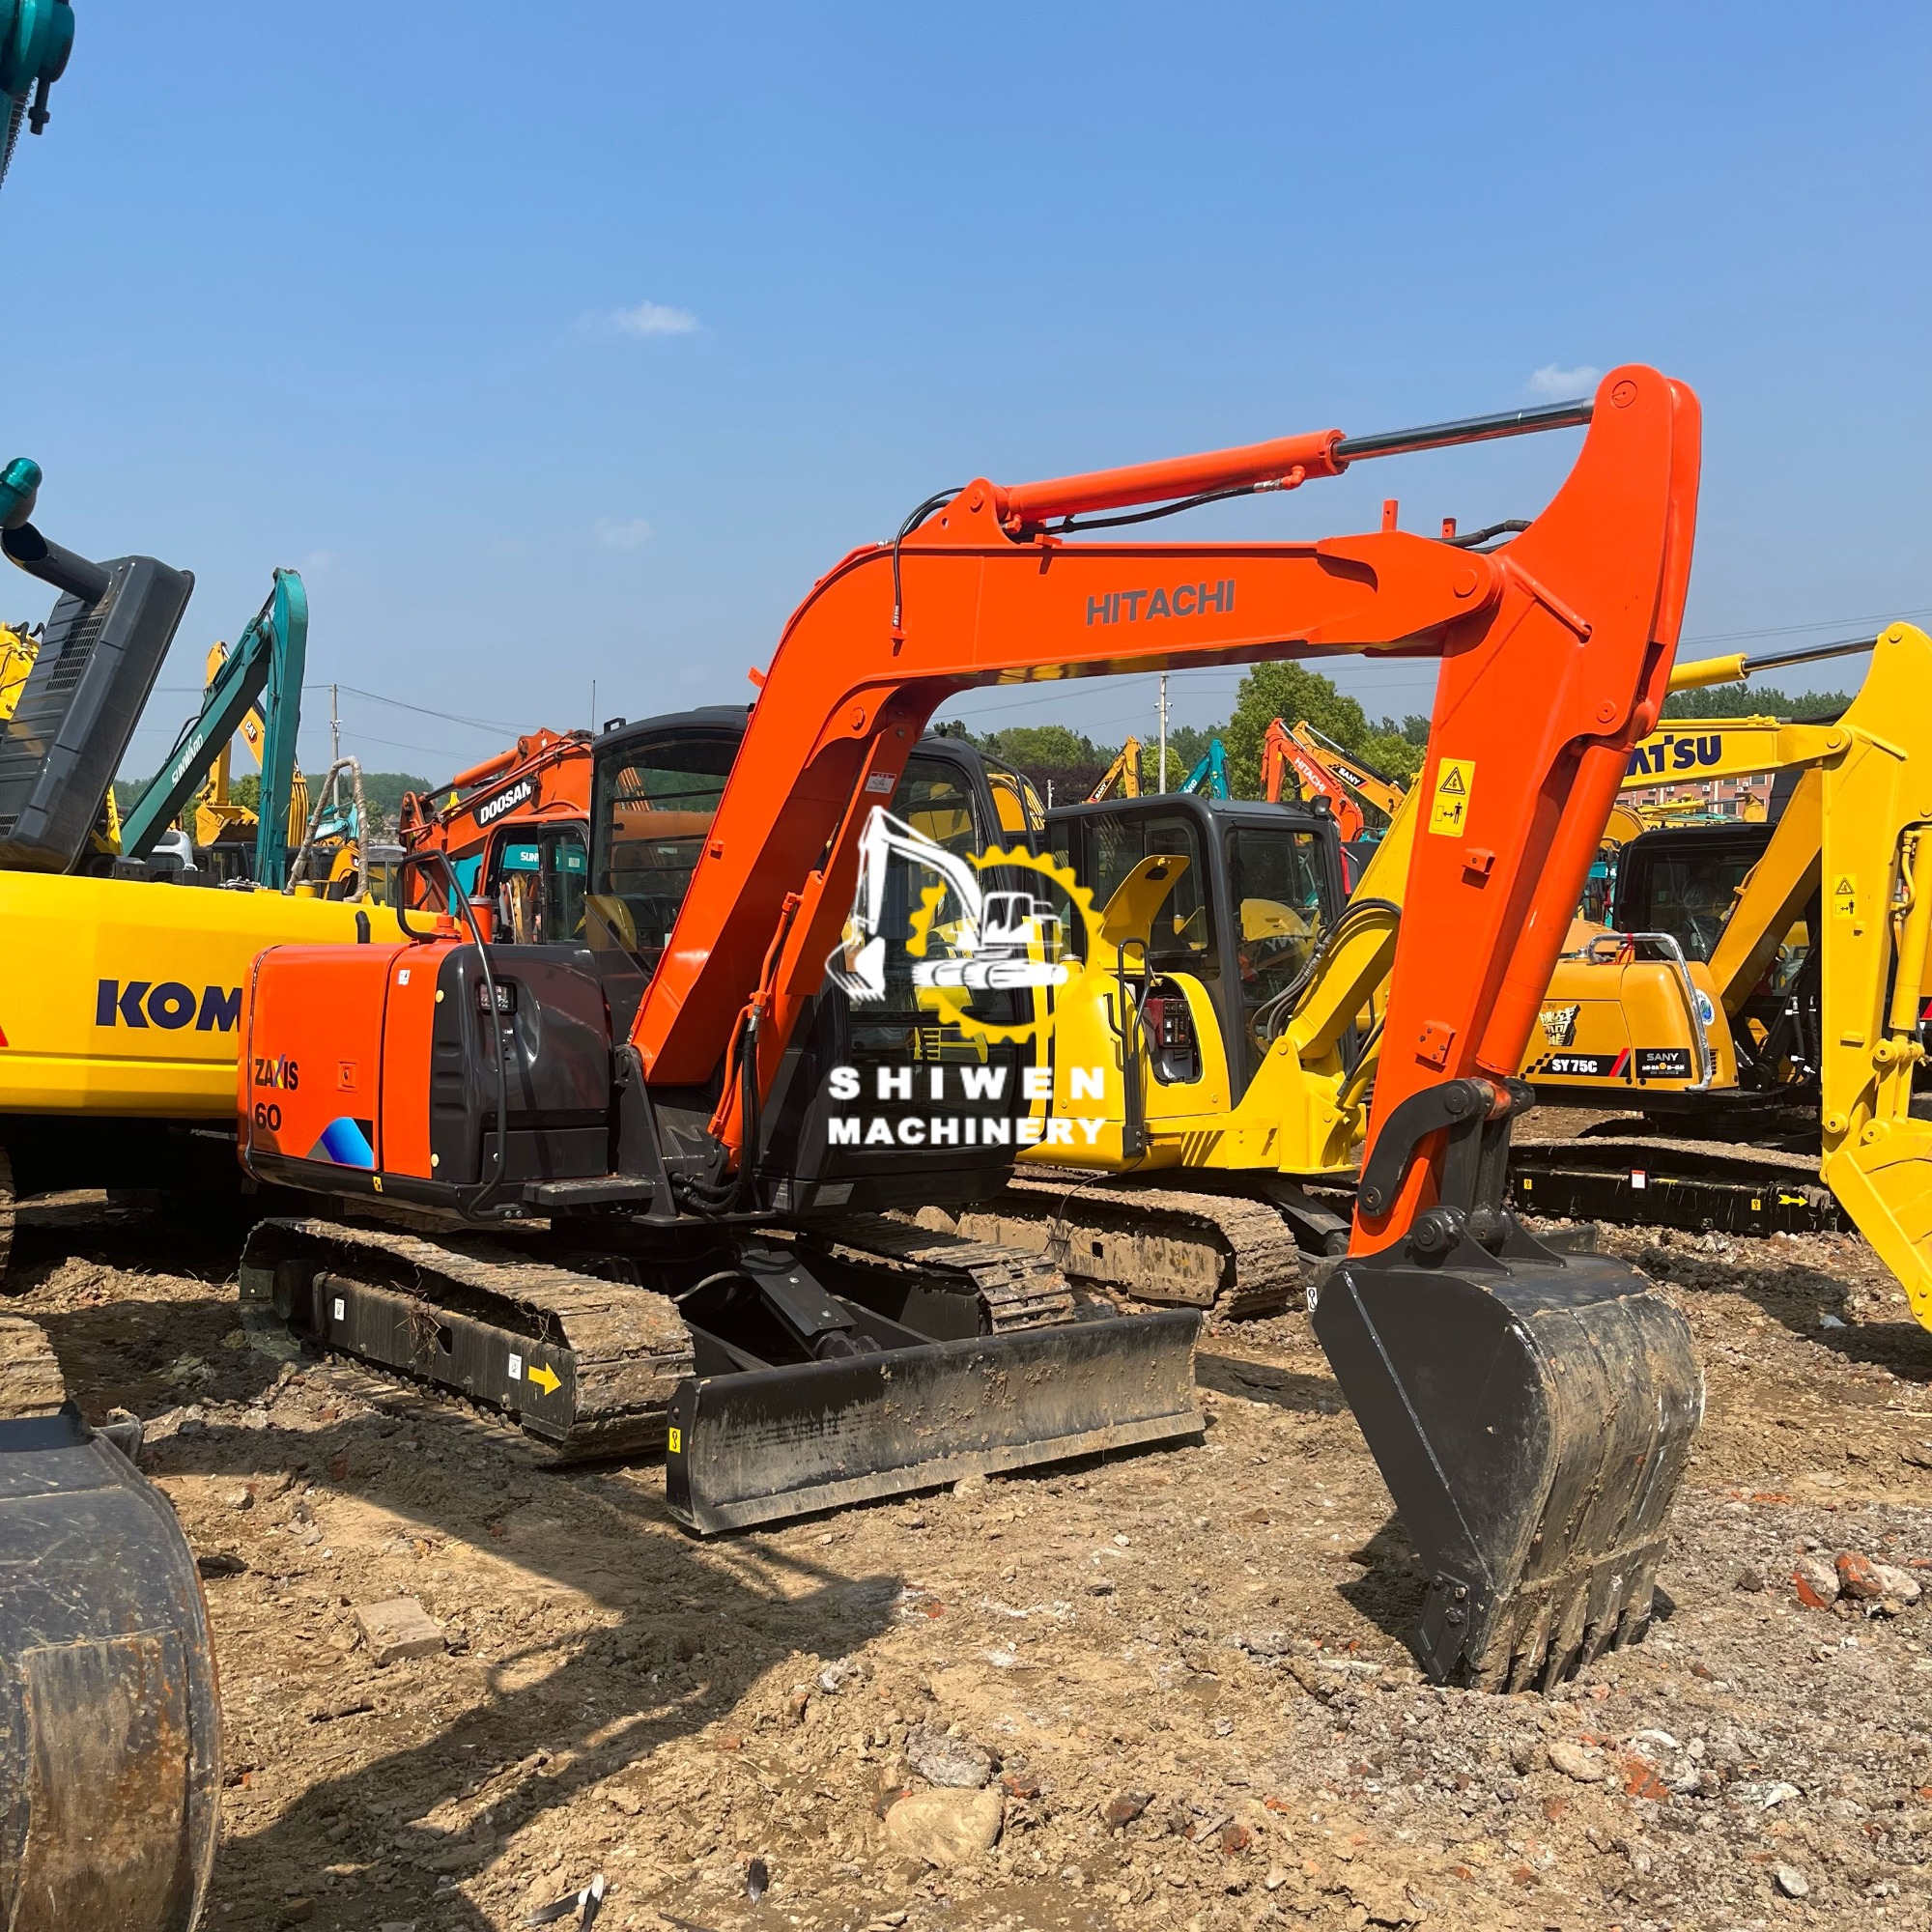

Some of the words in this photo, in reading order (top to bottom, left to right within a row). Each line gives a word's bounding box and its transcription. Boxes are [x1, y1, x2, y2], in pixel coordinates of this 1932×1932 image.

[1087, 580, 1236, 626] HITACHI
[171, 733, 204, 788] SUNWARD
[1294, 757, 1326, 793] HITACHI
[1338, 767, 1360, 785] SANY
[480, 781, 531, 824] DOOSAN
[1094, 781, 1107, 800] SANY
[96, 979, 242, 1032] KOM
[255, 1053, 298, 1091] ZAXIS
[1647, 1052, 1679, 1062] SANY
[254, 1102, 282, 1131] 60
